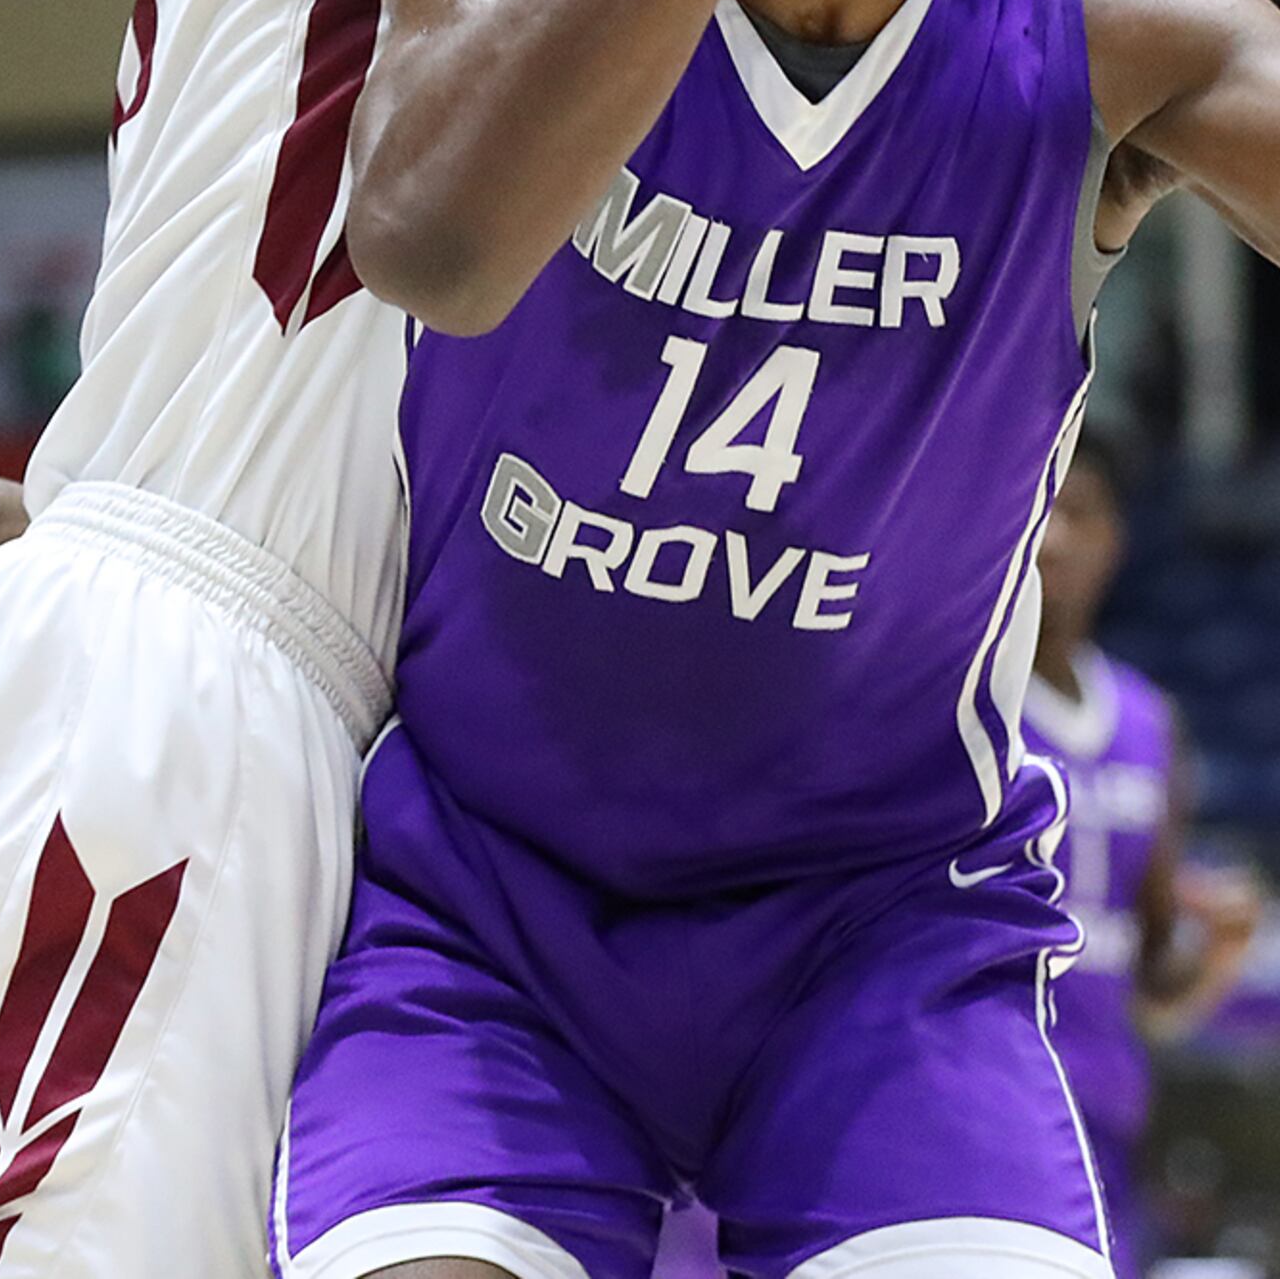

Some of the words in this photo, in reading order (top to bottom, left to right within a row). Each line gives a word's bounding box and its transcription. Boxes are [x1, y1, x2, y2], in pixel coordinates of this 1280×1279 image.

[572, 165, 961, 328] MILLER
[620, 334, 820, 512] 14
[480, 452, 870, 632] GROVE
